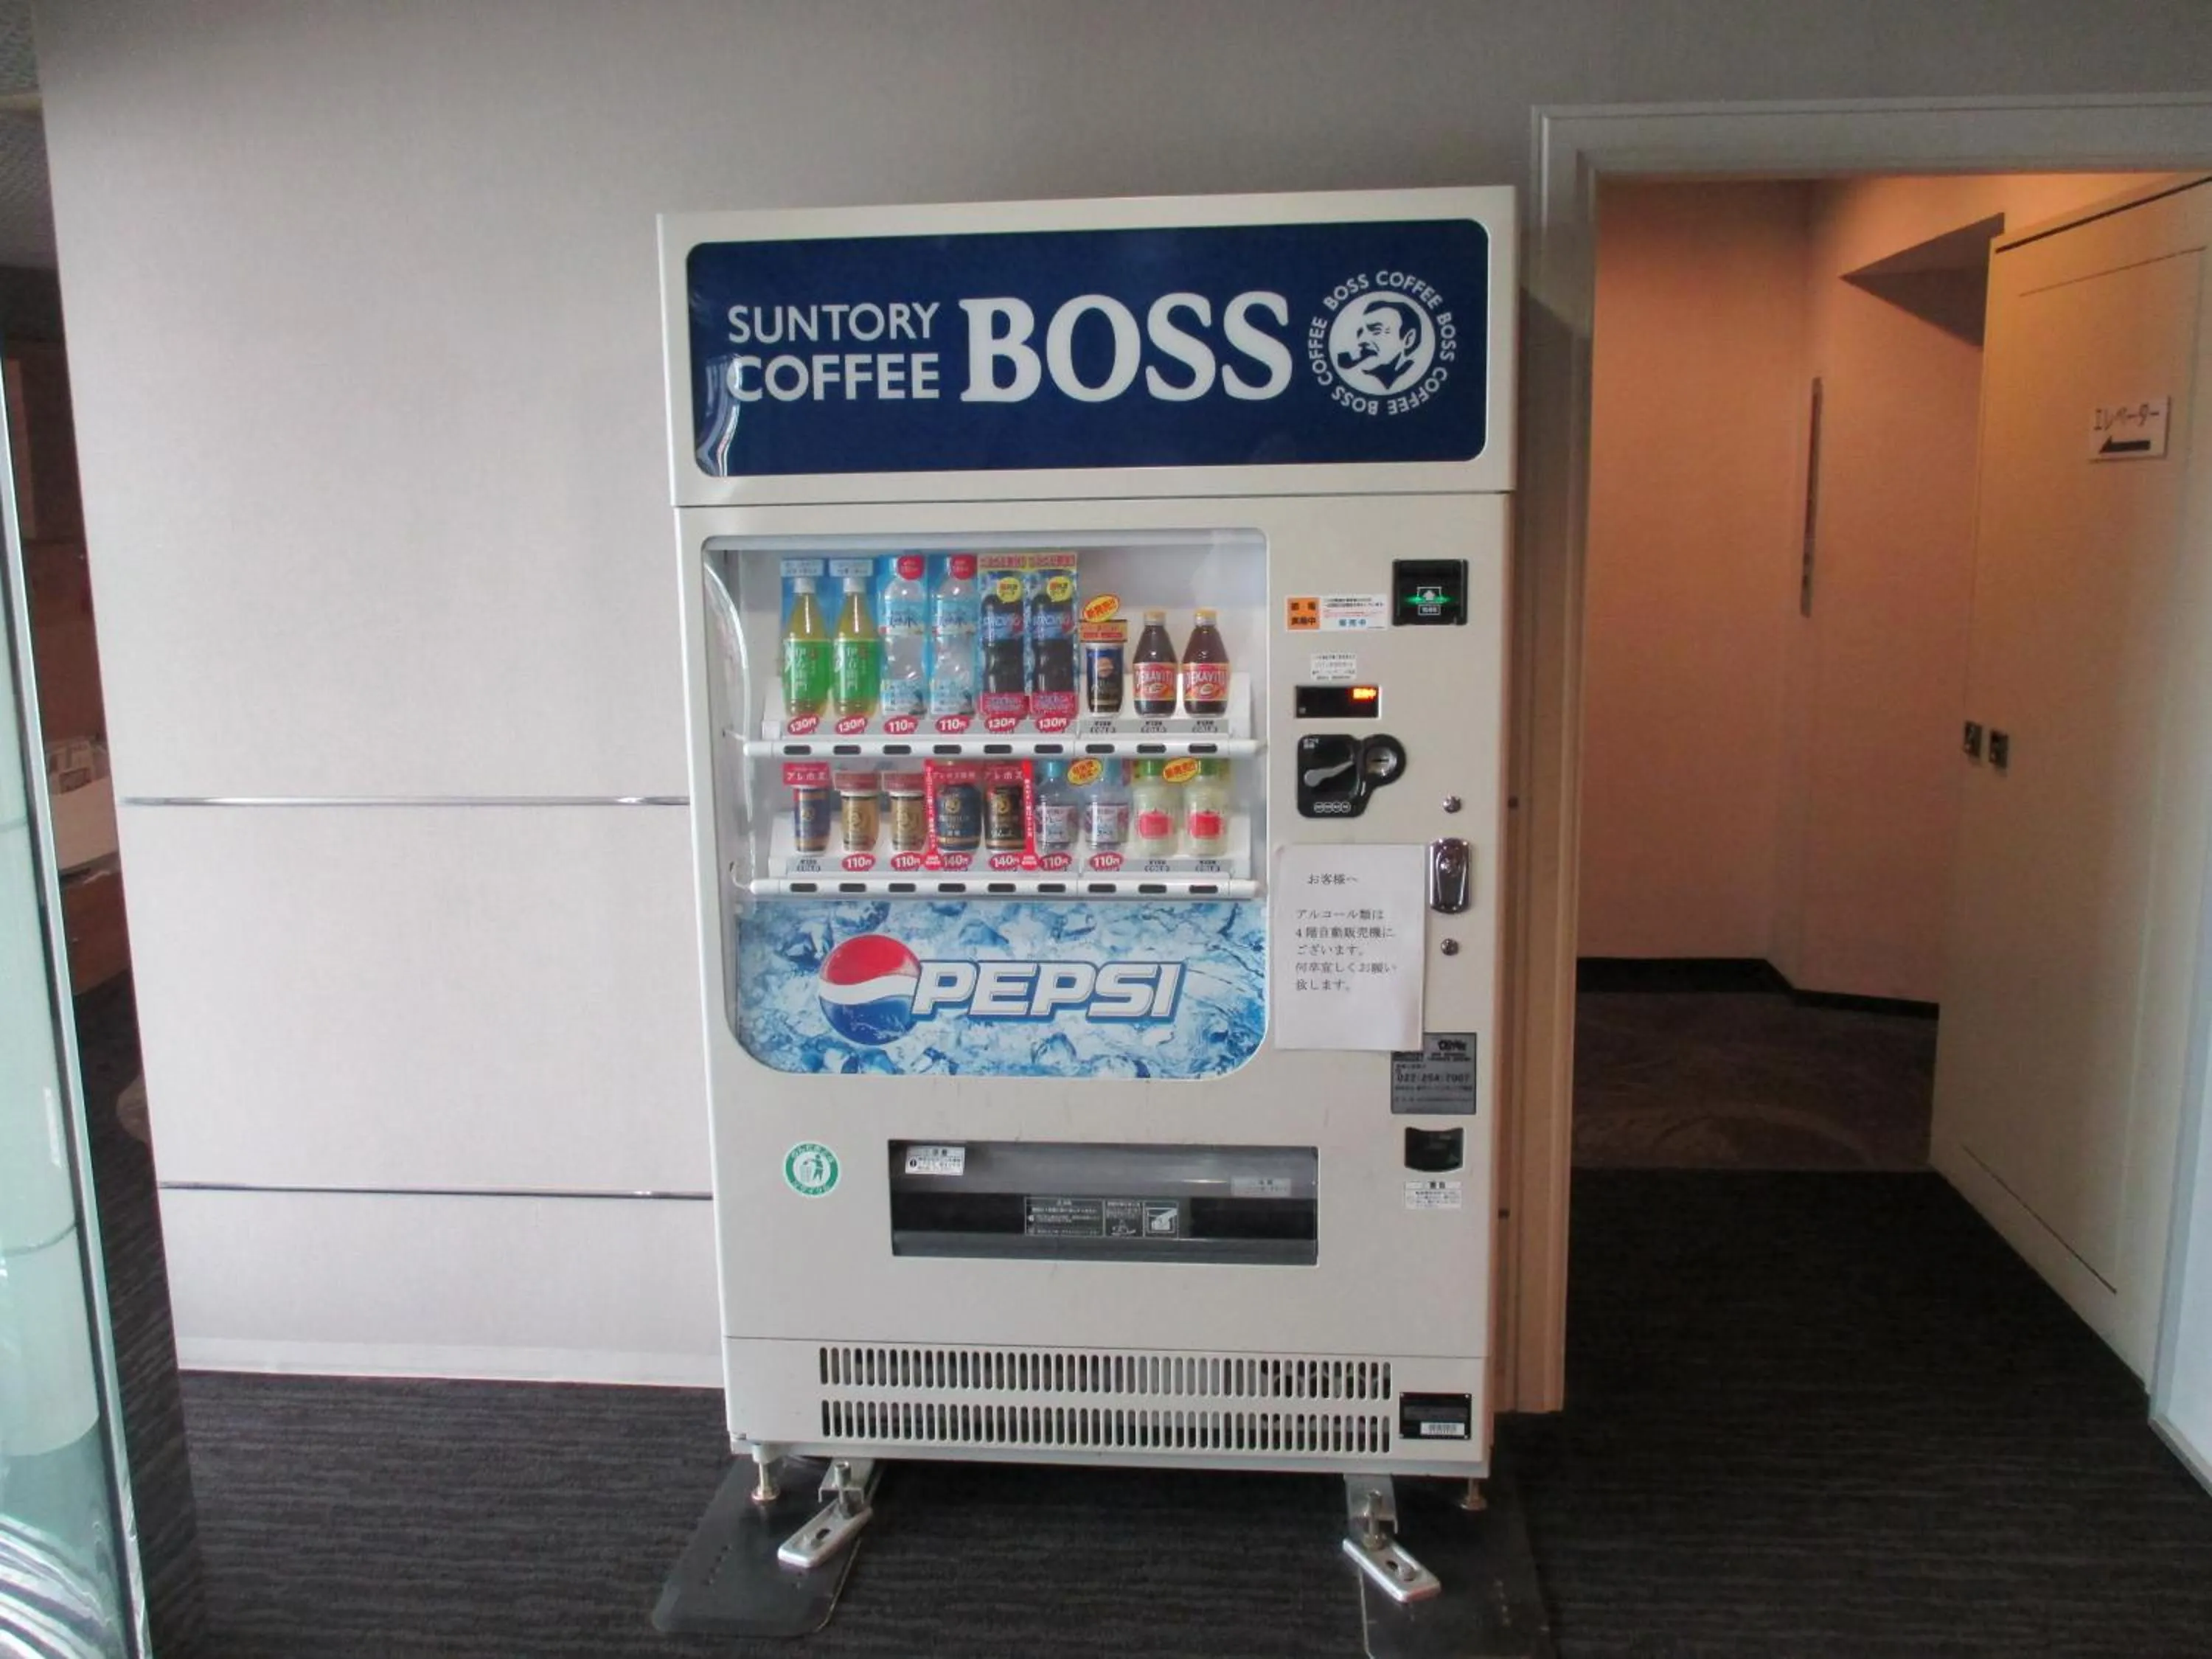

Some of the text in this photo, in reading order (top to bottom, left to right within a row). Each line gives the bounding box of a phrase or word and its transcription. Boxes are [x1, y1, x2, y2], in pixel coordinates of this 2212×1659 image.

[728, 302, 940, 344] SUNTORY
[959, 291, 1293, 402] BOSS
[1308, 270, 1456, 415] BOSS COFFEE BOSS COFFEE BOSS COFFEE
[726, 353, 939, 402] COFFEE
[1308, 873, 1358, 885] お客様へ
[1295, 909, 1384, 920] アルコール類は
[1295, 927, 1394, 938] 4階自動販売機に
[1298, 944, 1363, 956] ございます。
[911, 961, 1185, 1018] PEPSI
[1296, 978, 1350, 991] 致します。
